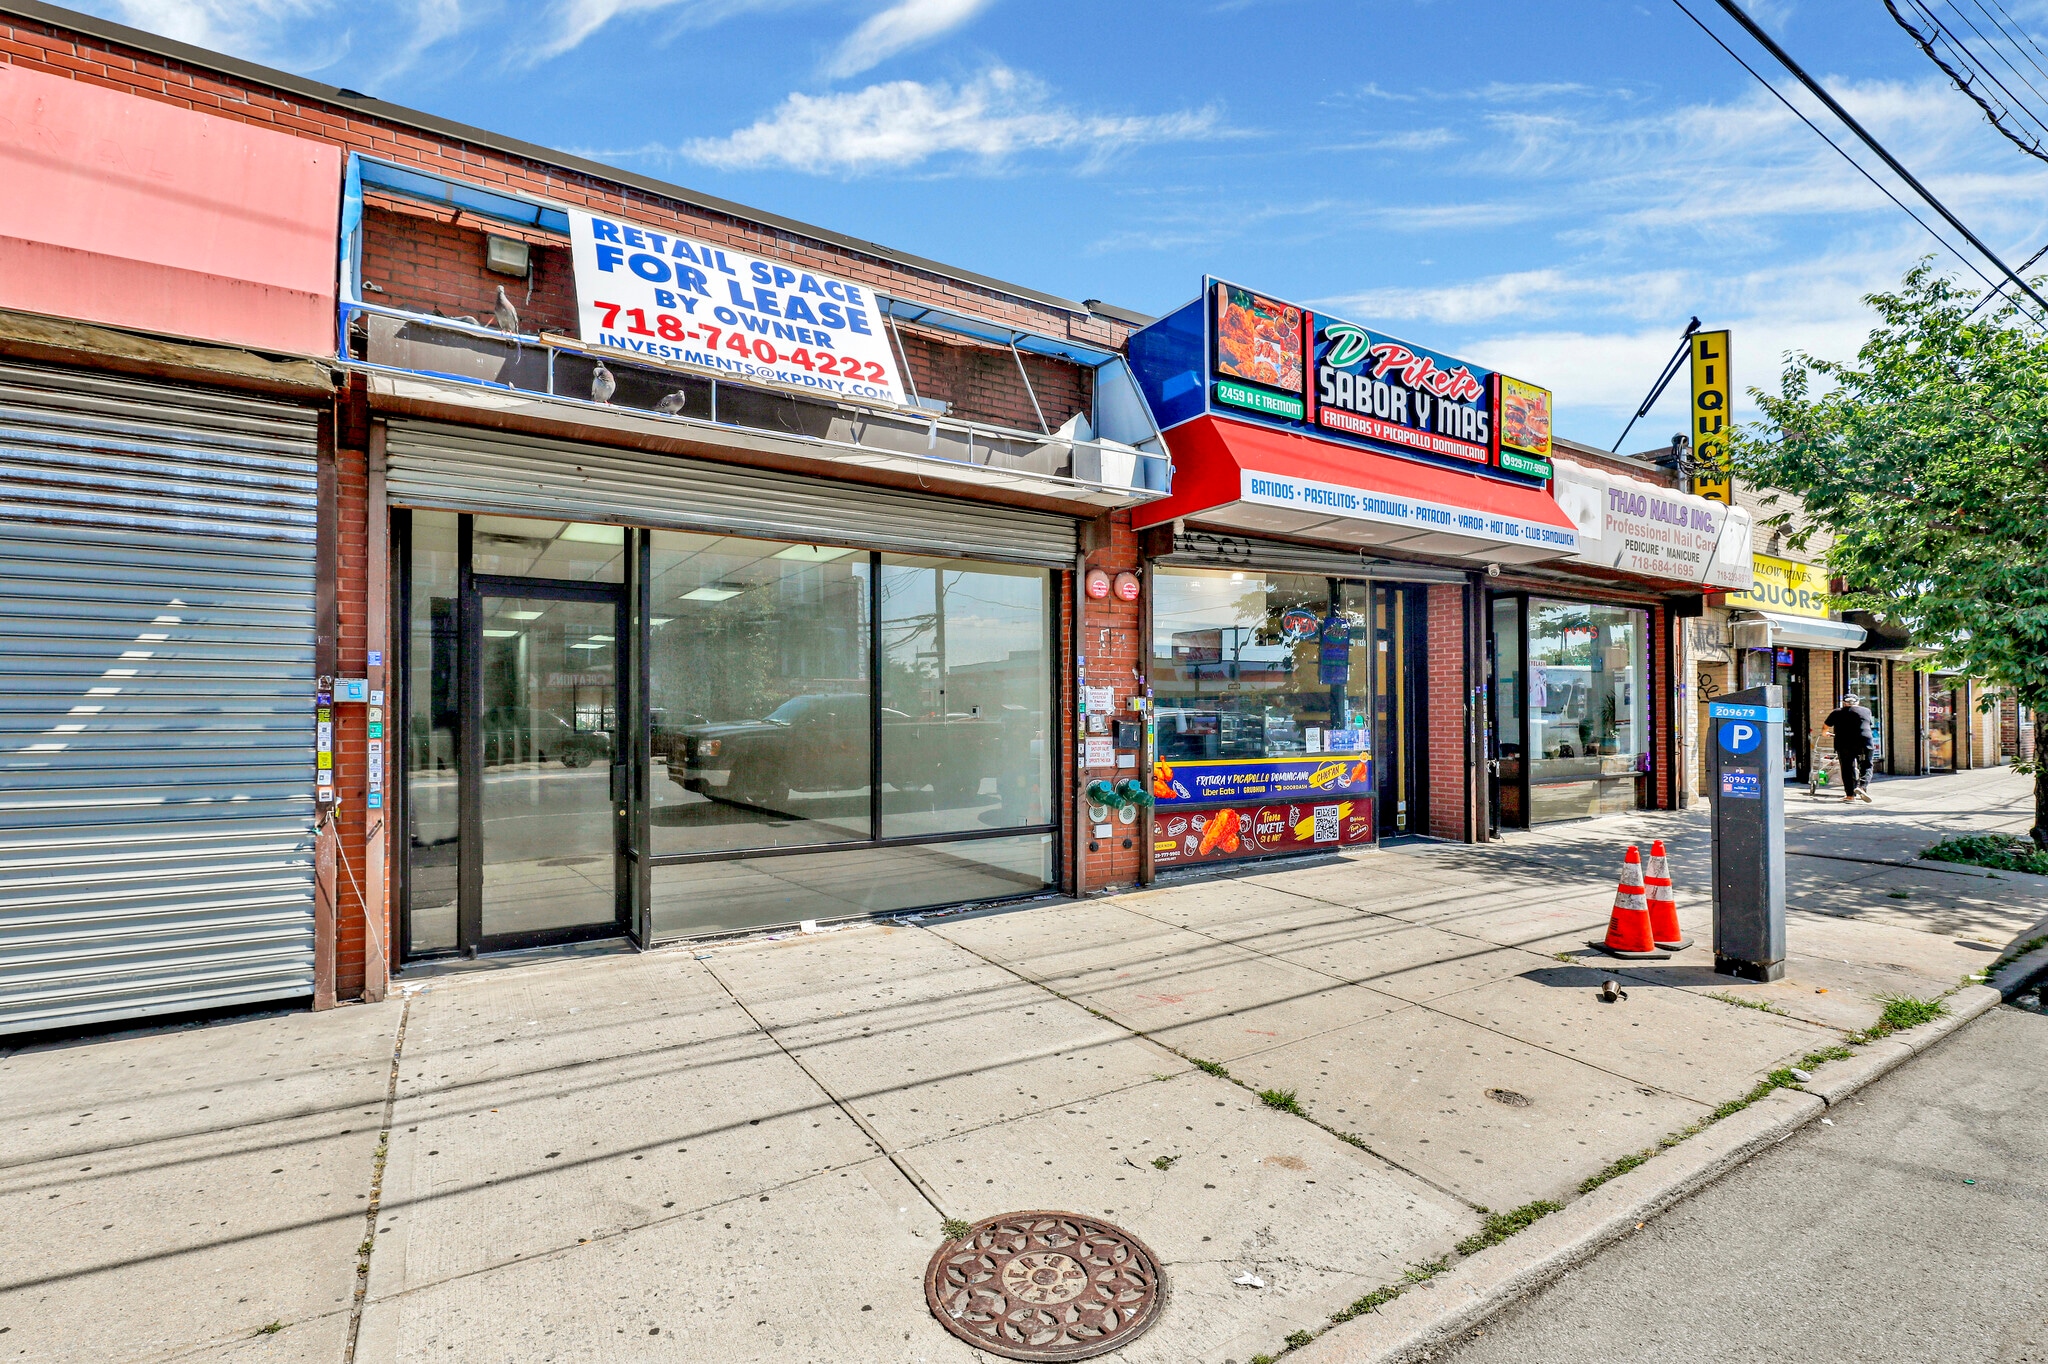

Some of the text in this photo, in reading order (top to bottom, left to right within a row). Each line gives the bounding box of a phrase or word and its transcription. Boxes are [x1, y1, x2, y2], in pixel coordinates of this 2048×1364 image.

[591, 217, 864, 308] RETAIL SPACE
[595, 243, 873, 337] FOR LEASE
[654, 288, 835, 350] BY OWNER
[593, 300, 889, 386] 718-740-4222
[599, 333, 893, 401] INVESTMENTS@KPDNY.COM
[1324, 324, 1484, 402] D Pikete
[1220, 385, 1303, 417] 2459 A E TREMONT
[1320, 365, 1491, 445] SABOR Y MAS
[1323, 410, 1487, 463] FRITURAS Y PICAPOLLO DOMINICANO
[1252, 479, 1575, 546] BATIDOS PASTELITOS SANDWICH PATACON YAROA HOT DOG CLUB SANDWICH
[1609, 488, 1715, 533] THAO NAILS INC.
[1606, 514, 1717, 553] Professional Nail Care
[1625, 540, 1700, 563] PEDICURE MANICURE
[1632, 556, 1694, 577] 718-684-1695
[1752, 562, 1812, 583] ILLOW WINES
[1284, 616, 1317, 633] OPEN
[1716, 708, 1755, 717] 209679
[1733, 725, 1753, 749] P
[1196, 771, 1309, 786] FRITURA Y PICAPOLLO DOMINICANO
[1202, 787, 1235, 796] Uber Eats
[1243, 785, 1266, 794] GRUBHUB
[1723, 775, 1757, 784] 209679
[1256, 821, 1285, 835] PIKETE
